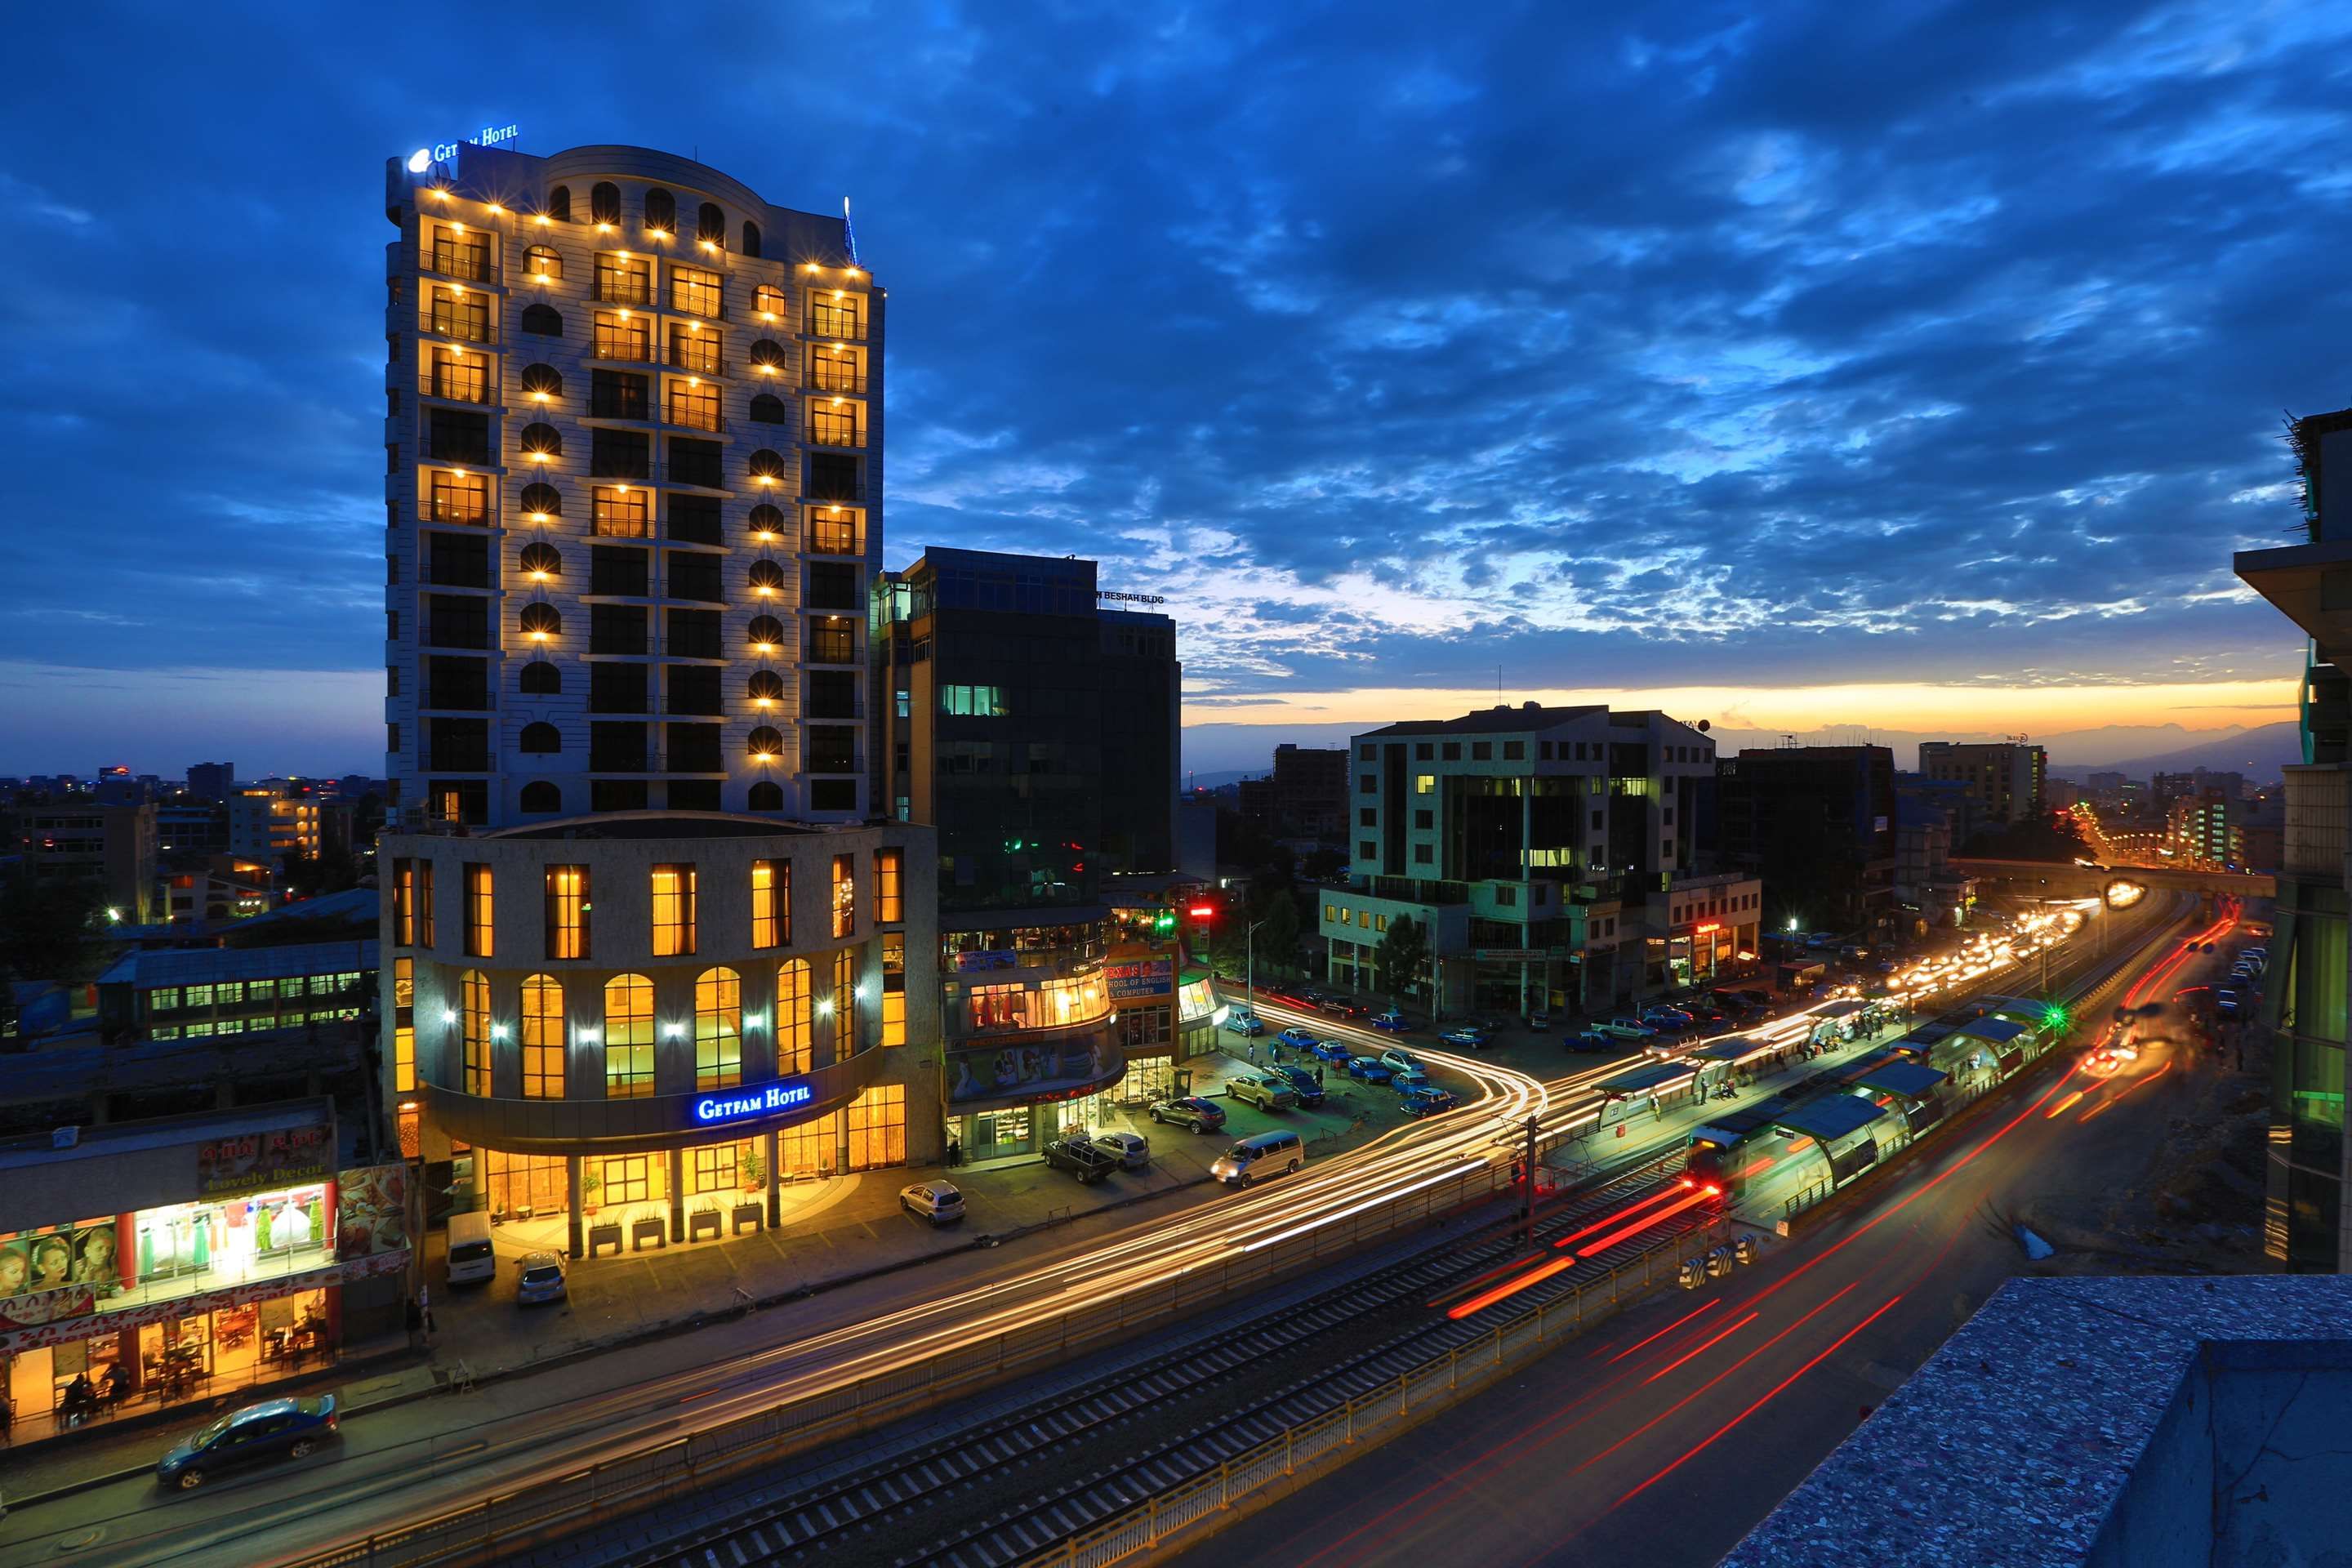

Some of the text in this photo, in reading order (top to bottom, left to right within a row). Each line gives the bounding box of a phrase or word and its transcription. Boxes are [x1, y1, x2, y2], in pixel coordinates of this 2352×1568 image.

[482, 124, 519, 146] HOTEL
[1104, 591, 1139, 602] BESHAH
[1141, 595, 1164, 604] BLDG
[1108, 976, 1171, 988] HOOL OF ENGLISH
[1116, 987, 1155, 997] COMPUTER
[698, 1086, 810, 1120] GETFAM HOTEL
[208, 1162, 327, 1191] Lovely Decor
[45, 1312, 179, 1347] Restaurant
[194, 1299, 234, 1315] and
